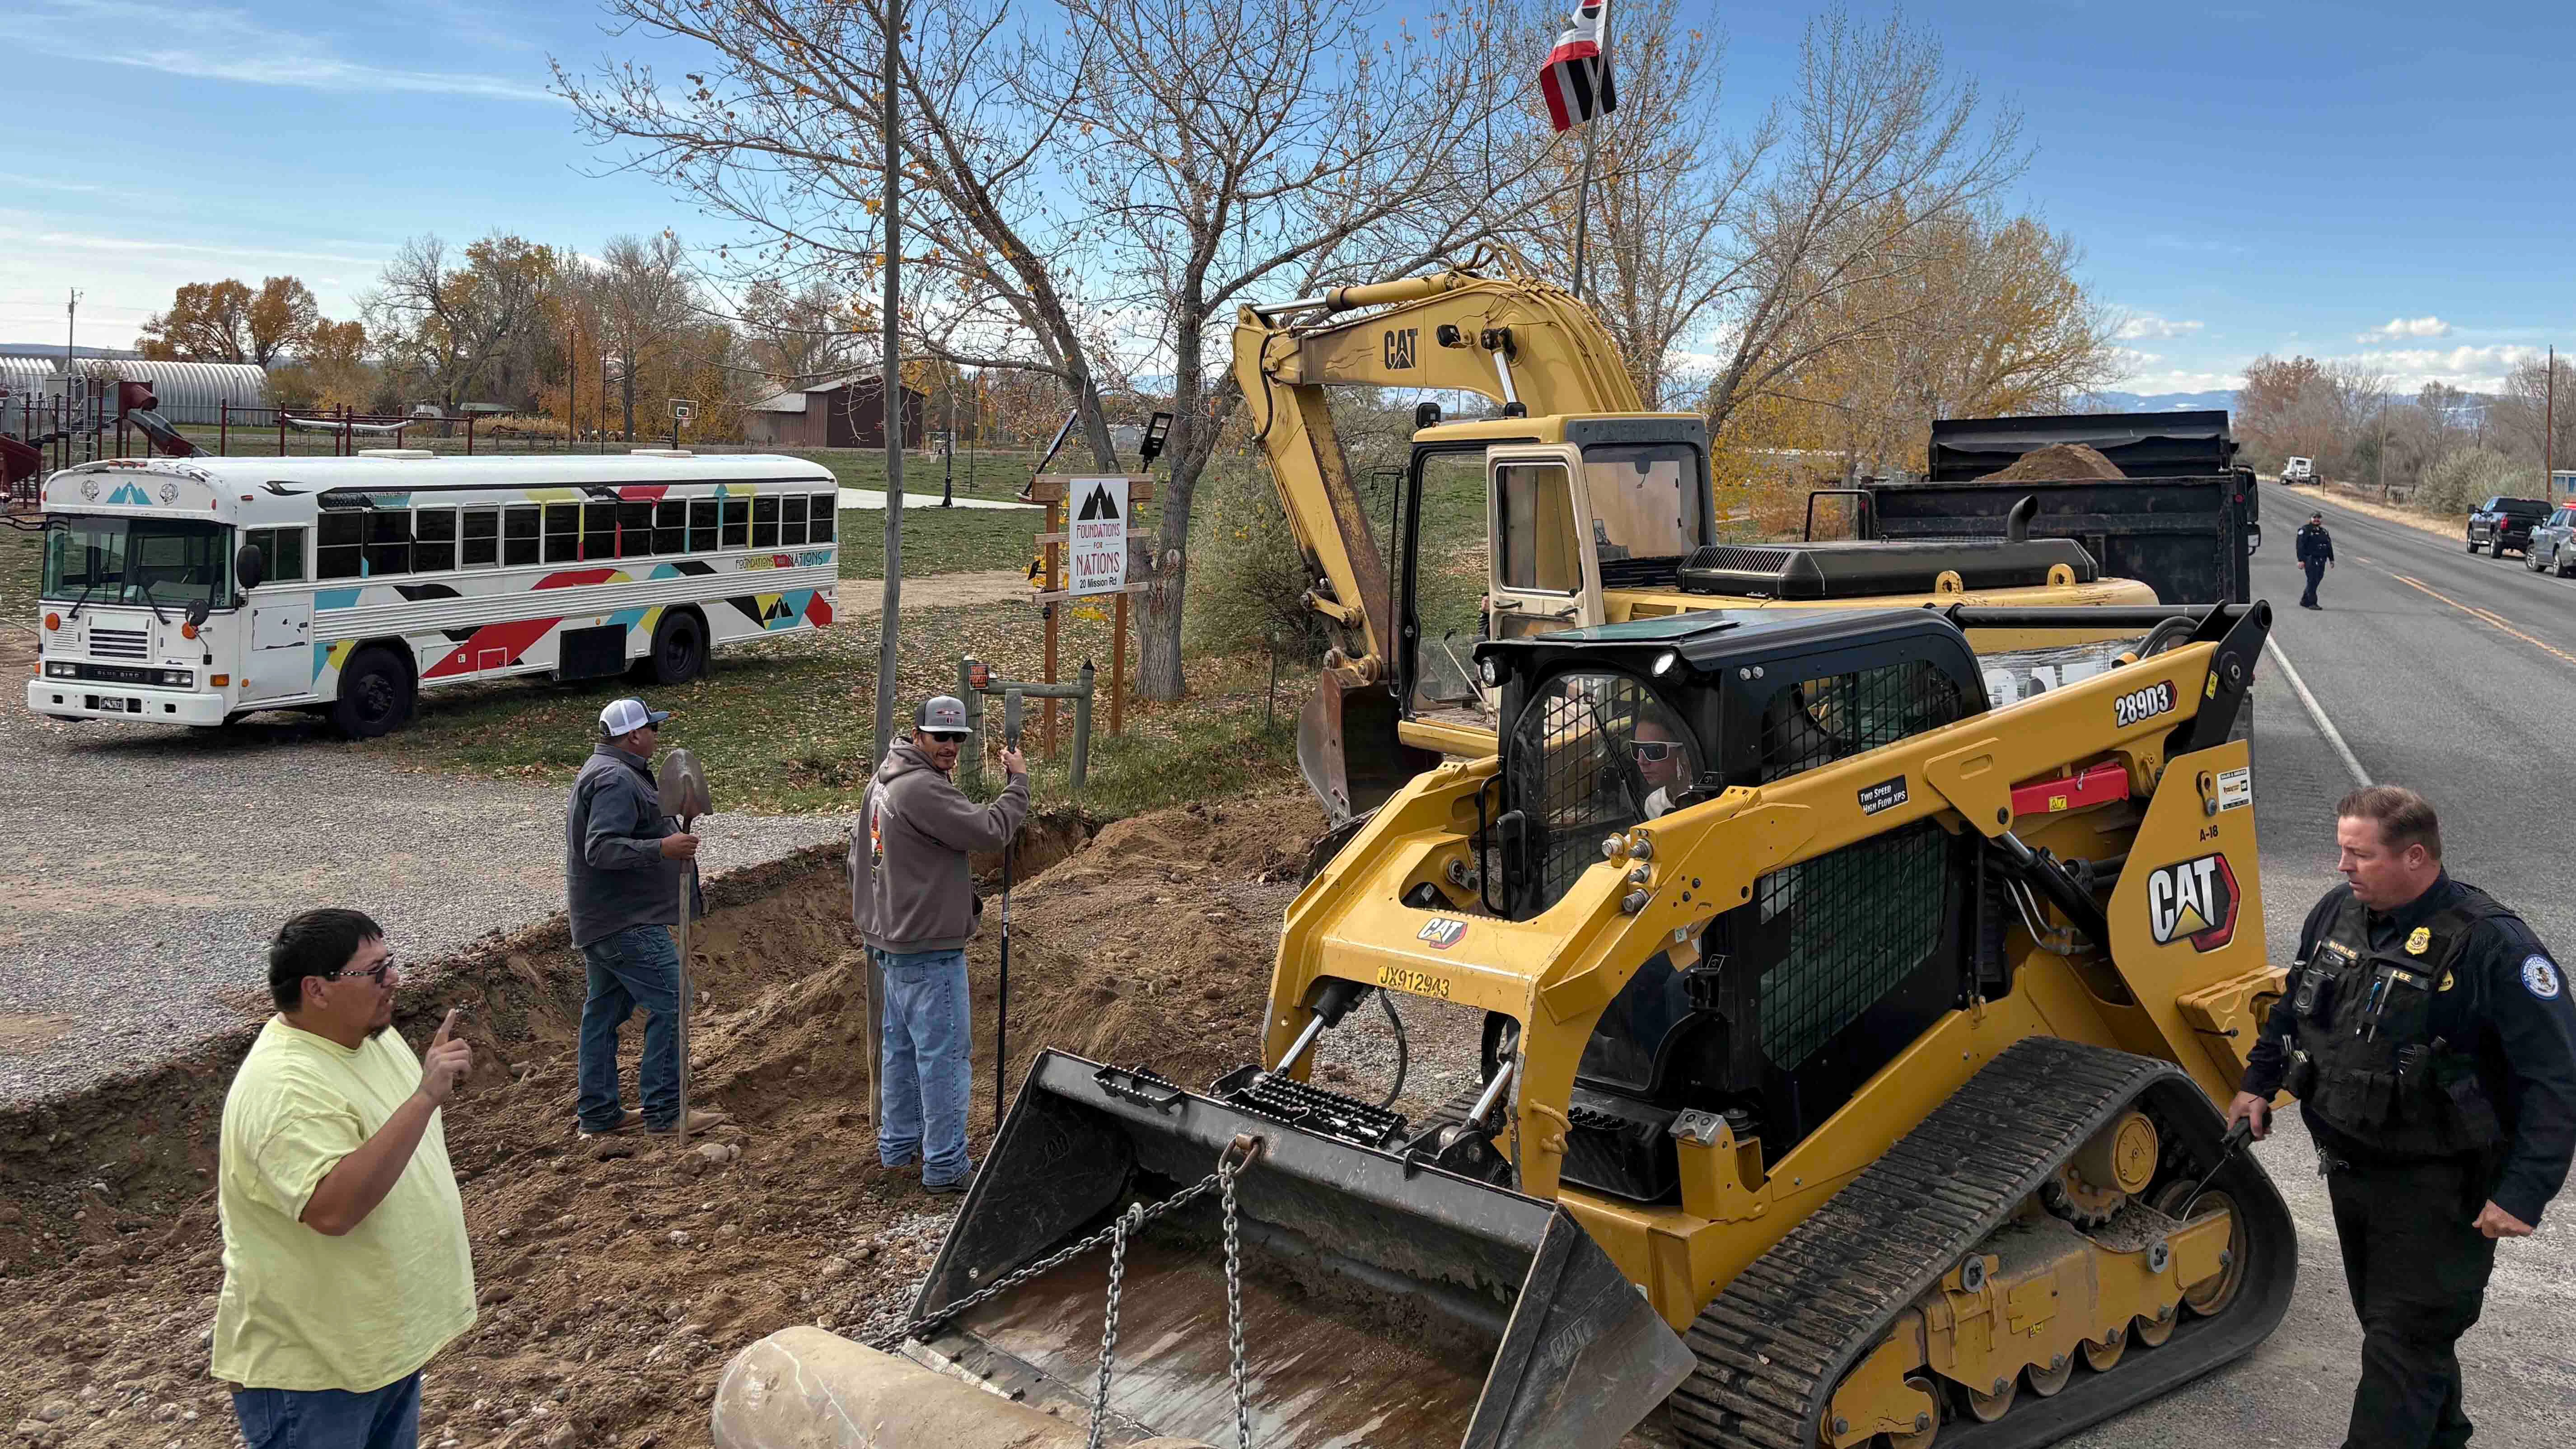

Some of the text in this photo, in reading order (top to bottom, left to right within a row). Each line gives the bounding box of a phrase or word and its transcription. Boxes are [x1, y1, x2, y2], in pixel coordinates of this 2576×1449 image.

[1384, 328, 1418, 369] CAT
[1077, 523, 1120, 538] FOUNDATIONS
[735, 556, 774, 570] FOUNDATIONS
[788, 551, 823, 568] NATIONS
[1077, 552, 1120, 576] NATIONS
[1080, 576, 1117, 589] 20 Mission Rd
[2116, 683, 2169, 727] 289D3
[1893, 790, 1906, 803] XPS
[2200, 825, 2218, 842] A-18
[2149, 856, 2216, 942] CAT
[1418, 918, 1464, 942] CAT
[1380, 966, 1449, 998] JX912943
[1550, 1318, 1585, 1364] CAT
